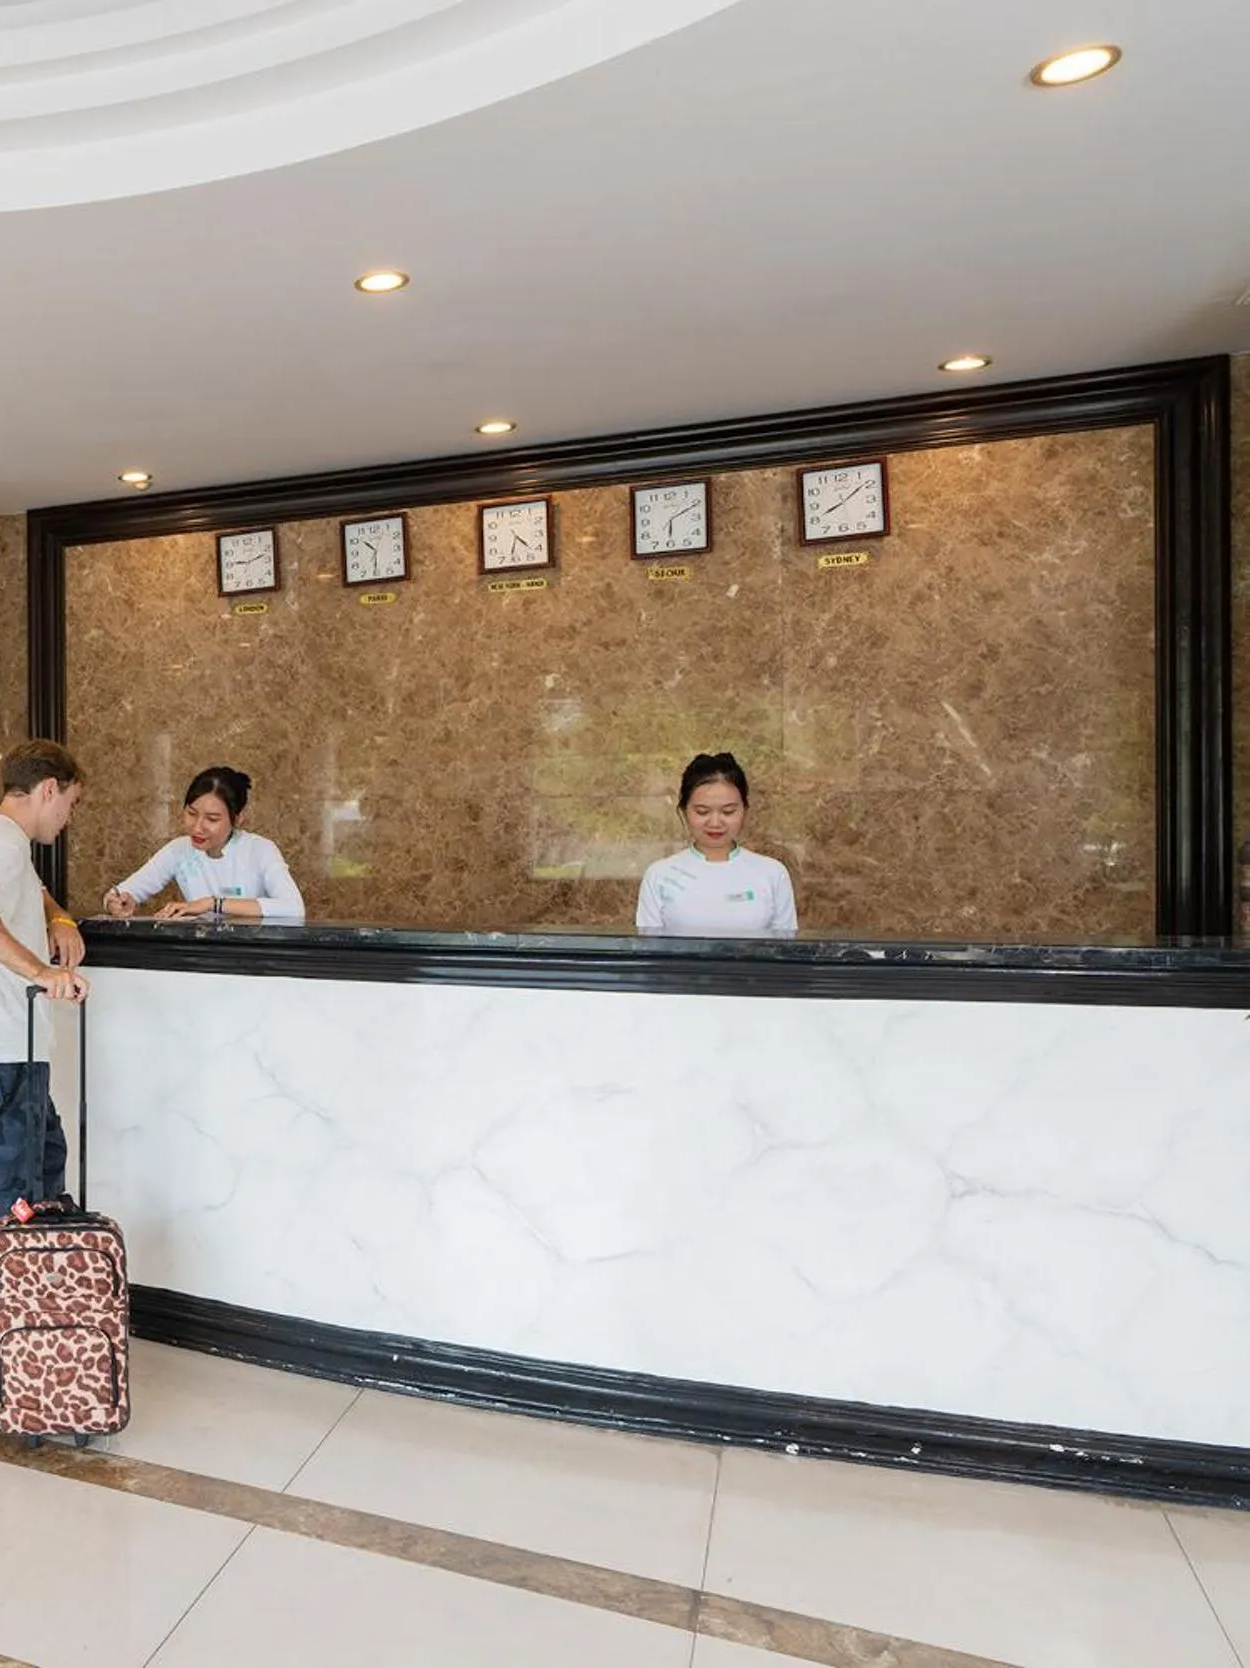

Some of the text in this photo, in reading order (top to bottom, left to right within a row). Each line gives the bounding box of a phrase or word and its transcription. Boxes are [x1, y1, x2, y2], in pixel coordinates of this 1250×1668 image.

[818, 475, 828, 484] 11
[834, 472, 848, 482] 12
[865, 480, 876, 489] 2
[808, 488, 820, 496] 10
[865, 495, 876, 504] 3
[810, 502, 819, 510] 9
[866, 511, 876, 519] 4
[810, 516, 820, 525] 8
[822, 525, 831, 534] 7
[838, 523, 849, 532] 6
[856, 521, 867, 531] 5
[824, 555, 861, 565] SYDNEY
[367, 594, 388, 603] PARIS
[238, 605, 265, 613] LONDON
